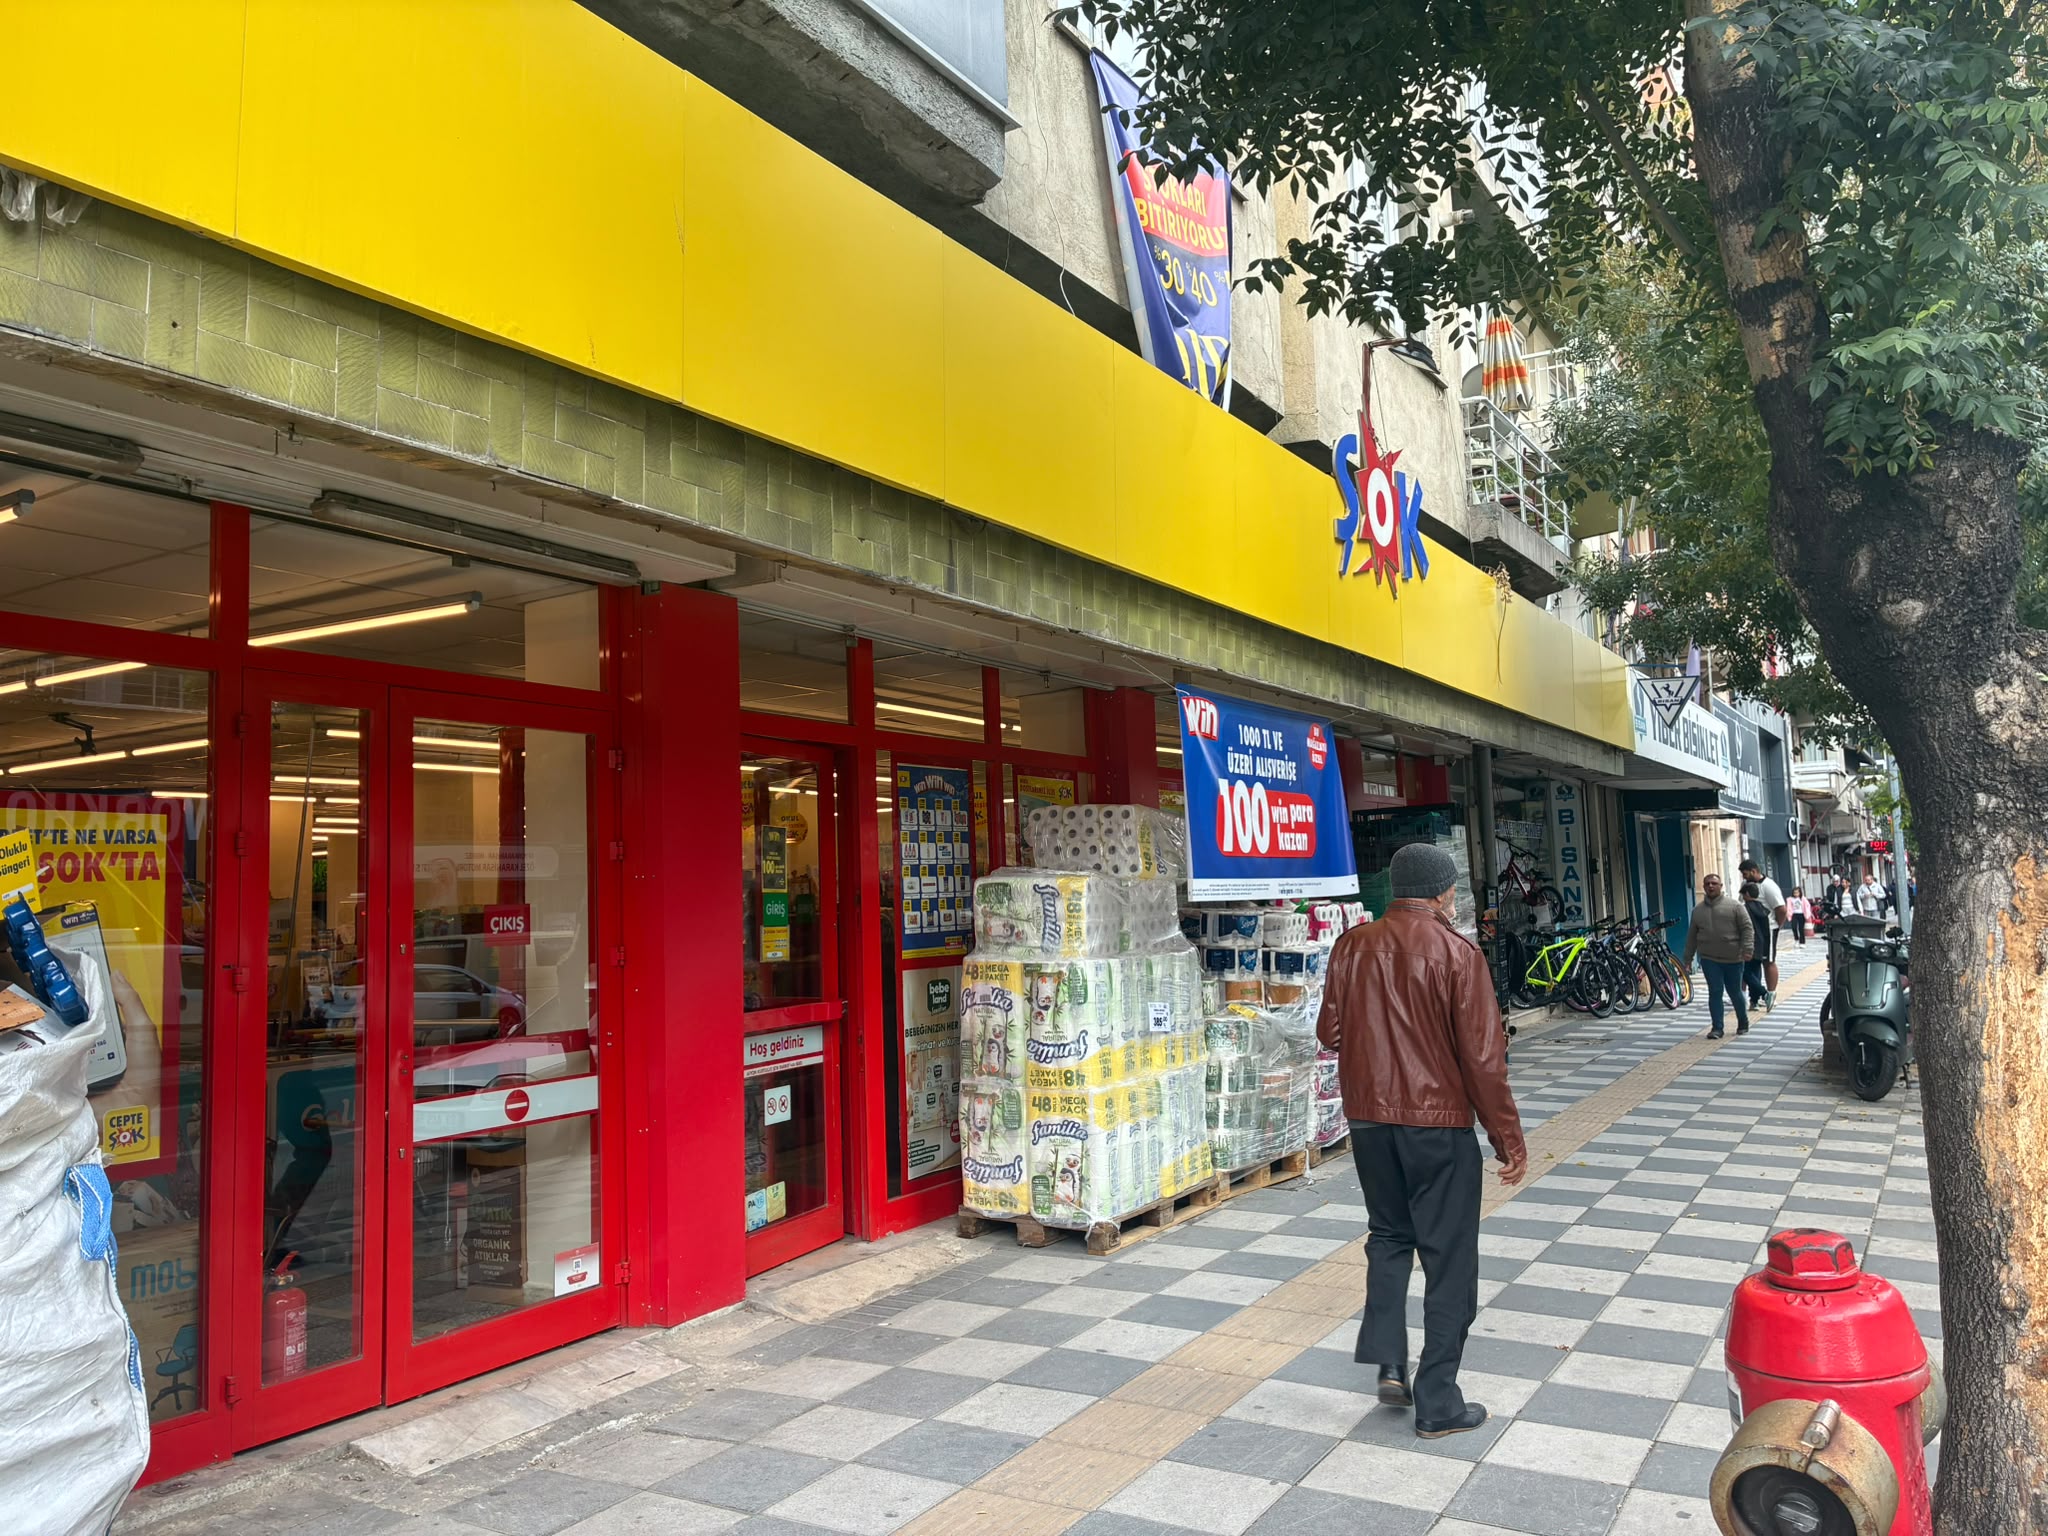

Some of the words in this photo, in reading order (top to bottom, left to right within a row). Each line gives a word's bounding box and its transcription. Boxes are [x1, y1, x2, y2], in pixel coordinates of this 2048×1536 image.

[1143, 166, 1207, 217] SOKLARI
[1134, 194, 1227, 250] BİTİRİYORU
[1333, 433, 1430, 581] ŞOK
[1238, 723, 1261, 748] 1000
[1263, 728, 1272, 749] TL
[1273, 731, 1283, 752] VE
[1682, 709, 1719, 767] BİSİKLET
[1227, 747, 1254, 776] ÜZERİ
[1255, 755, 1297, 786] ALIŞVERİŞE
[1218, 778, 1270, 854] 100
[1271, 798, 1289, 824] win
[1289, 803, 1314, 830] para
[75, 829, 97, 845] NE
[104, 829, 157, 845] VARSA
[1277, 823, 1308, 852] kazan
[37, 851, 161, 894] ŞOK'TA
[766, 901, 785, 918] GİRİŞ
[490, 915, 525, 934] ÇIKIŞ
[965, 964, 979, 980] 48
[985, 964, 1010, 973] MEGA
[985, 973, 1010, 981] PAKET
[929, 982, 950, 995] bebe
[932, 993, 947, 1004] land
[905, 1023, 946, 1038] BEBEĞİNİZİN
[947, 1021, 959, 1031] HER
[750, 1042, 768, 1057] Hoş
[770, 1034, 804, 1056] geldiniz
[1026, 1030, 1089, 1064] familia
[1030, 1069, 1057, 1078] PAKET
[1030, 1078, 1058, 1087] MEGA
[1032, 1096, 1052, 1113] 48
[1060, 1096, 1087, 1105] MEGA
[1060, 1105, 1088, 1114] PACK
[109, 1112, 143, 1128] CEPTE
[109, 1127, 145, 1151] ŞOK
[1032, 1120, 1088, 1145] familia
[963, 1155, 1023, 1184] familia
[473, 1237, 511, 1250] ORGANİK
[474, 1252, 510, 1263] ATIKLAR
